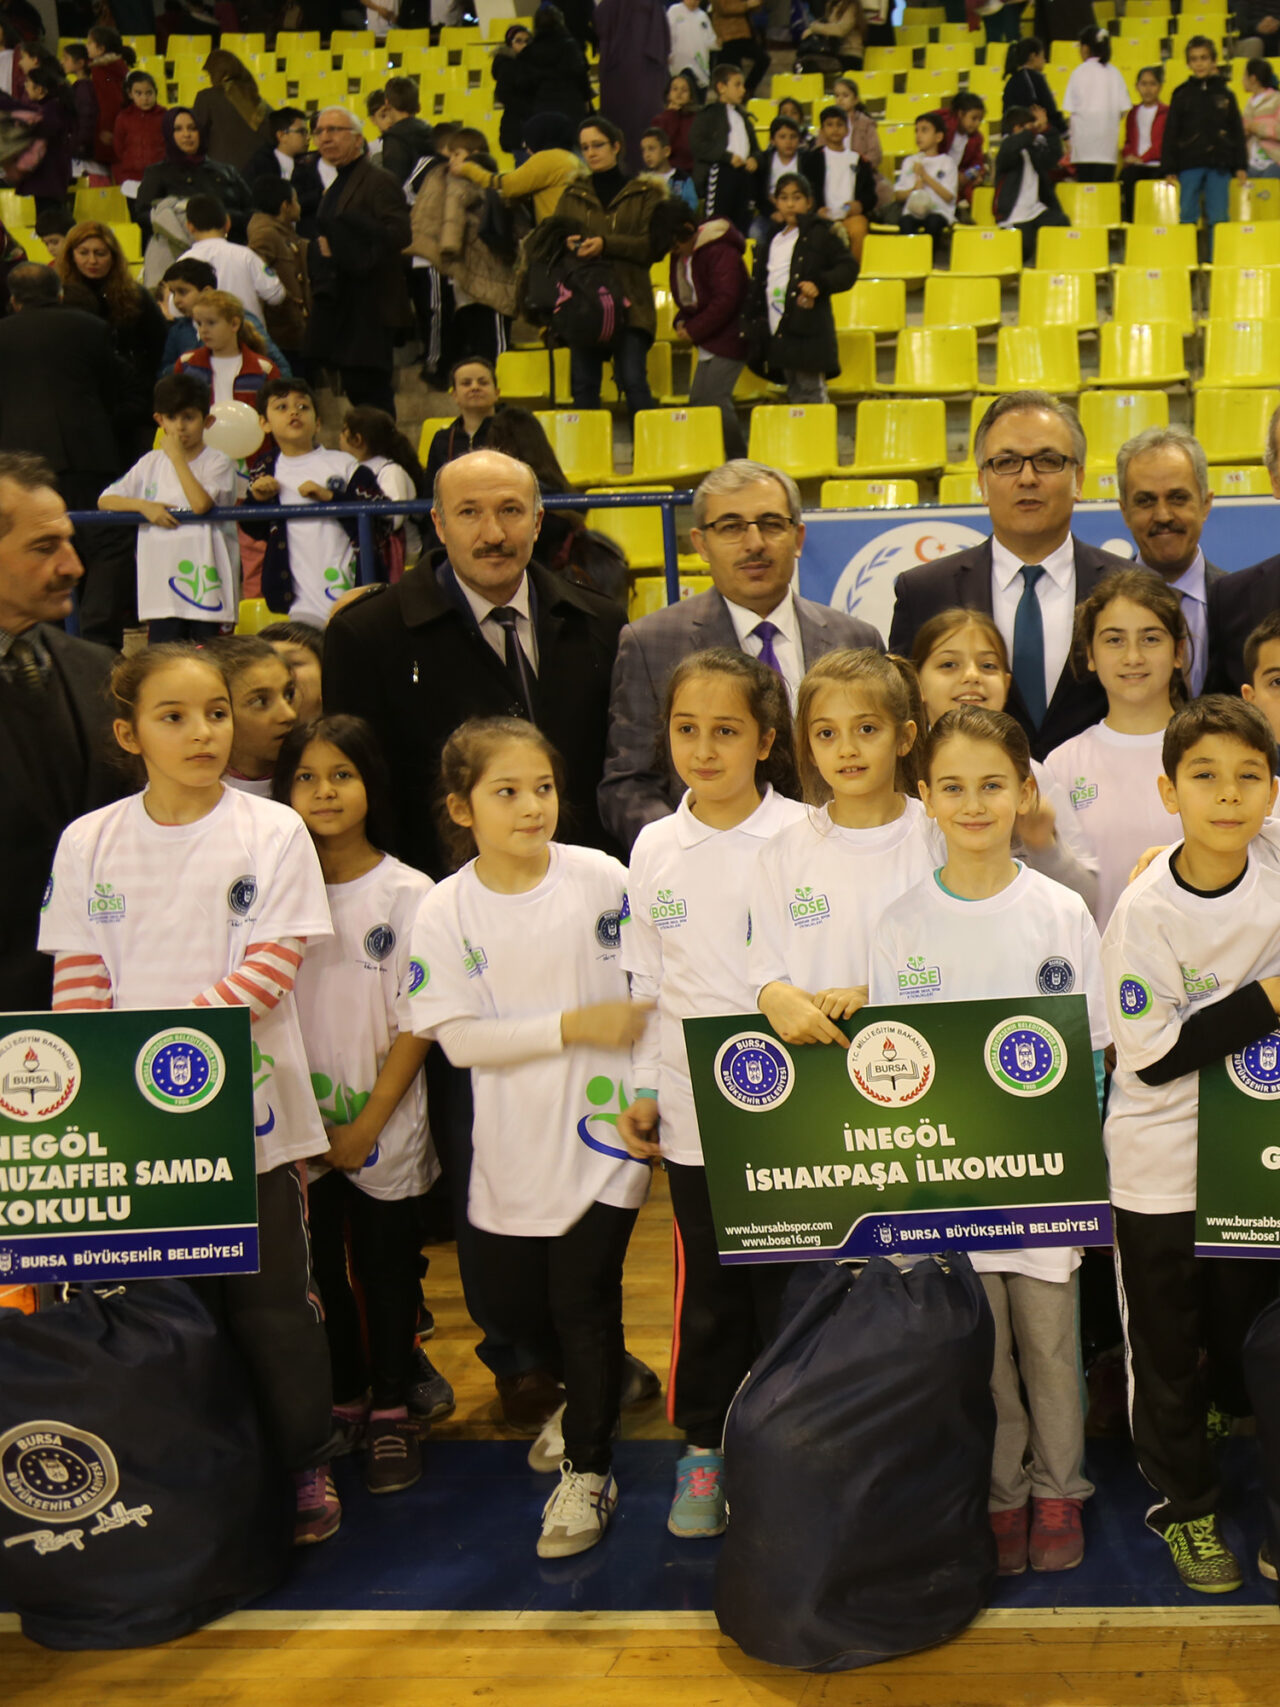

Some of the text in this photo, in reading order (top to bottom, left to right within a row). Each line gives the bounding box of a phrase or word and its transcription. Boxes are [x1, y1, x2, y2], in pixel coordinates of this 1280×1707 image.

[91, 897, 125, 914] BOSE
[651, 902, 684, 919] BOSE
[792, 898, 827, 918] BOSE
[898, 970, 938, 987] BOSE
[1184, 975, 1216, 993] OSE
[735, 1039, 767, 1051] BURSA
[875, 1064, 908, 1073] BURSA
[14, 1074, 50, 1085] BURSA
[0, 1125, 107, 1160] EGÖL
[843, 1118, 956, 1152] İNEGÖL
[135, 1157, 233, 1185] SAMDA
[745, 1152, 1064, 1191] İSHAKPAŞA İLKOKULU
[725, 1220, 833, 1236] www.bursabbspor.com
[900, 1216, 1099, 1241] BURSA BÜYÜKŞEHİR BELEDİYESİ
[741, 1233, 821, 1248] www.bose16.org
[21, 1242, 243, 1268] BURSA BÜYÜKŞEHİR BELEDİYESİ
[16, 1434, 62, 1450] BURSA
[6, 1472, 71, 1511] BÜYÜKŞEHİR
